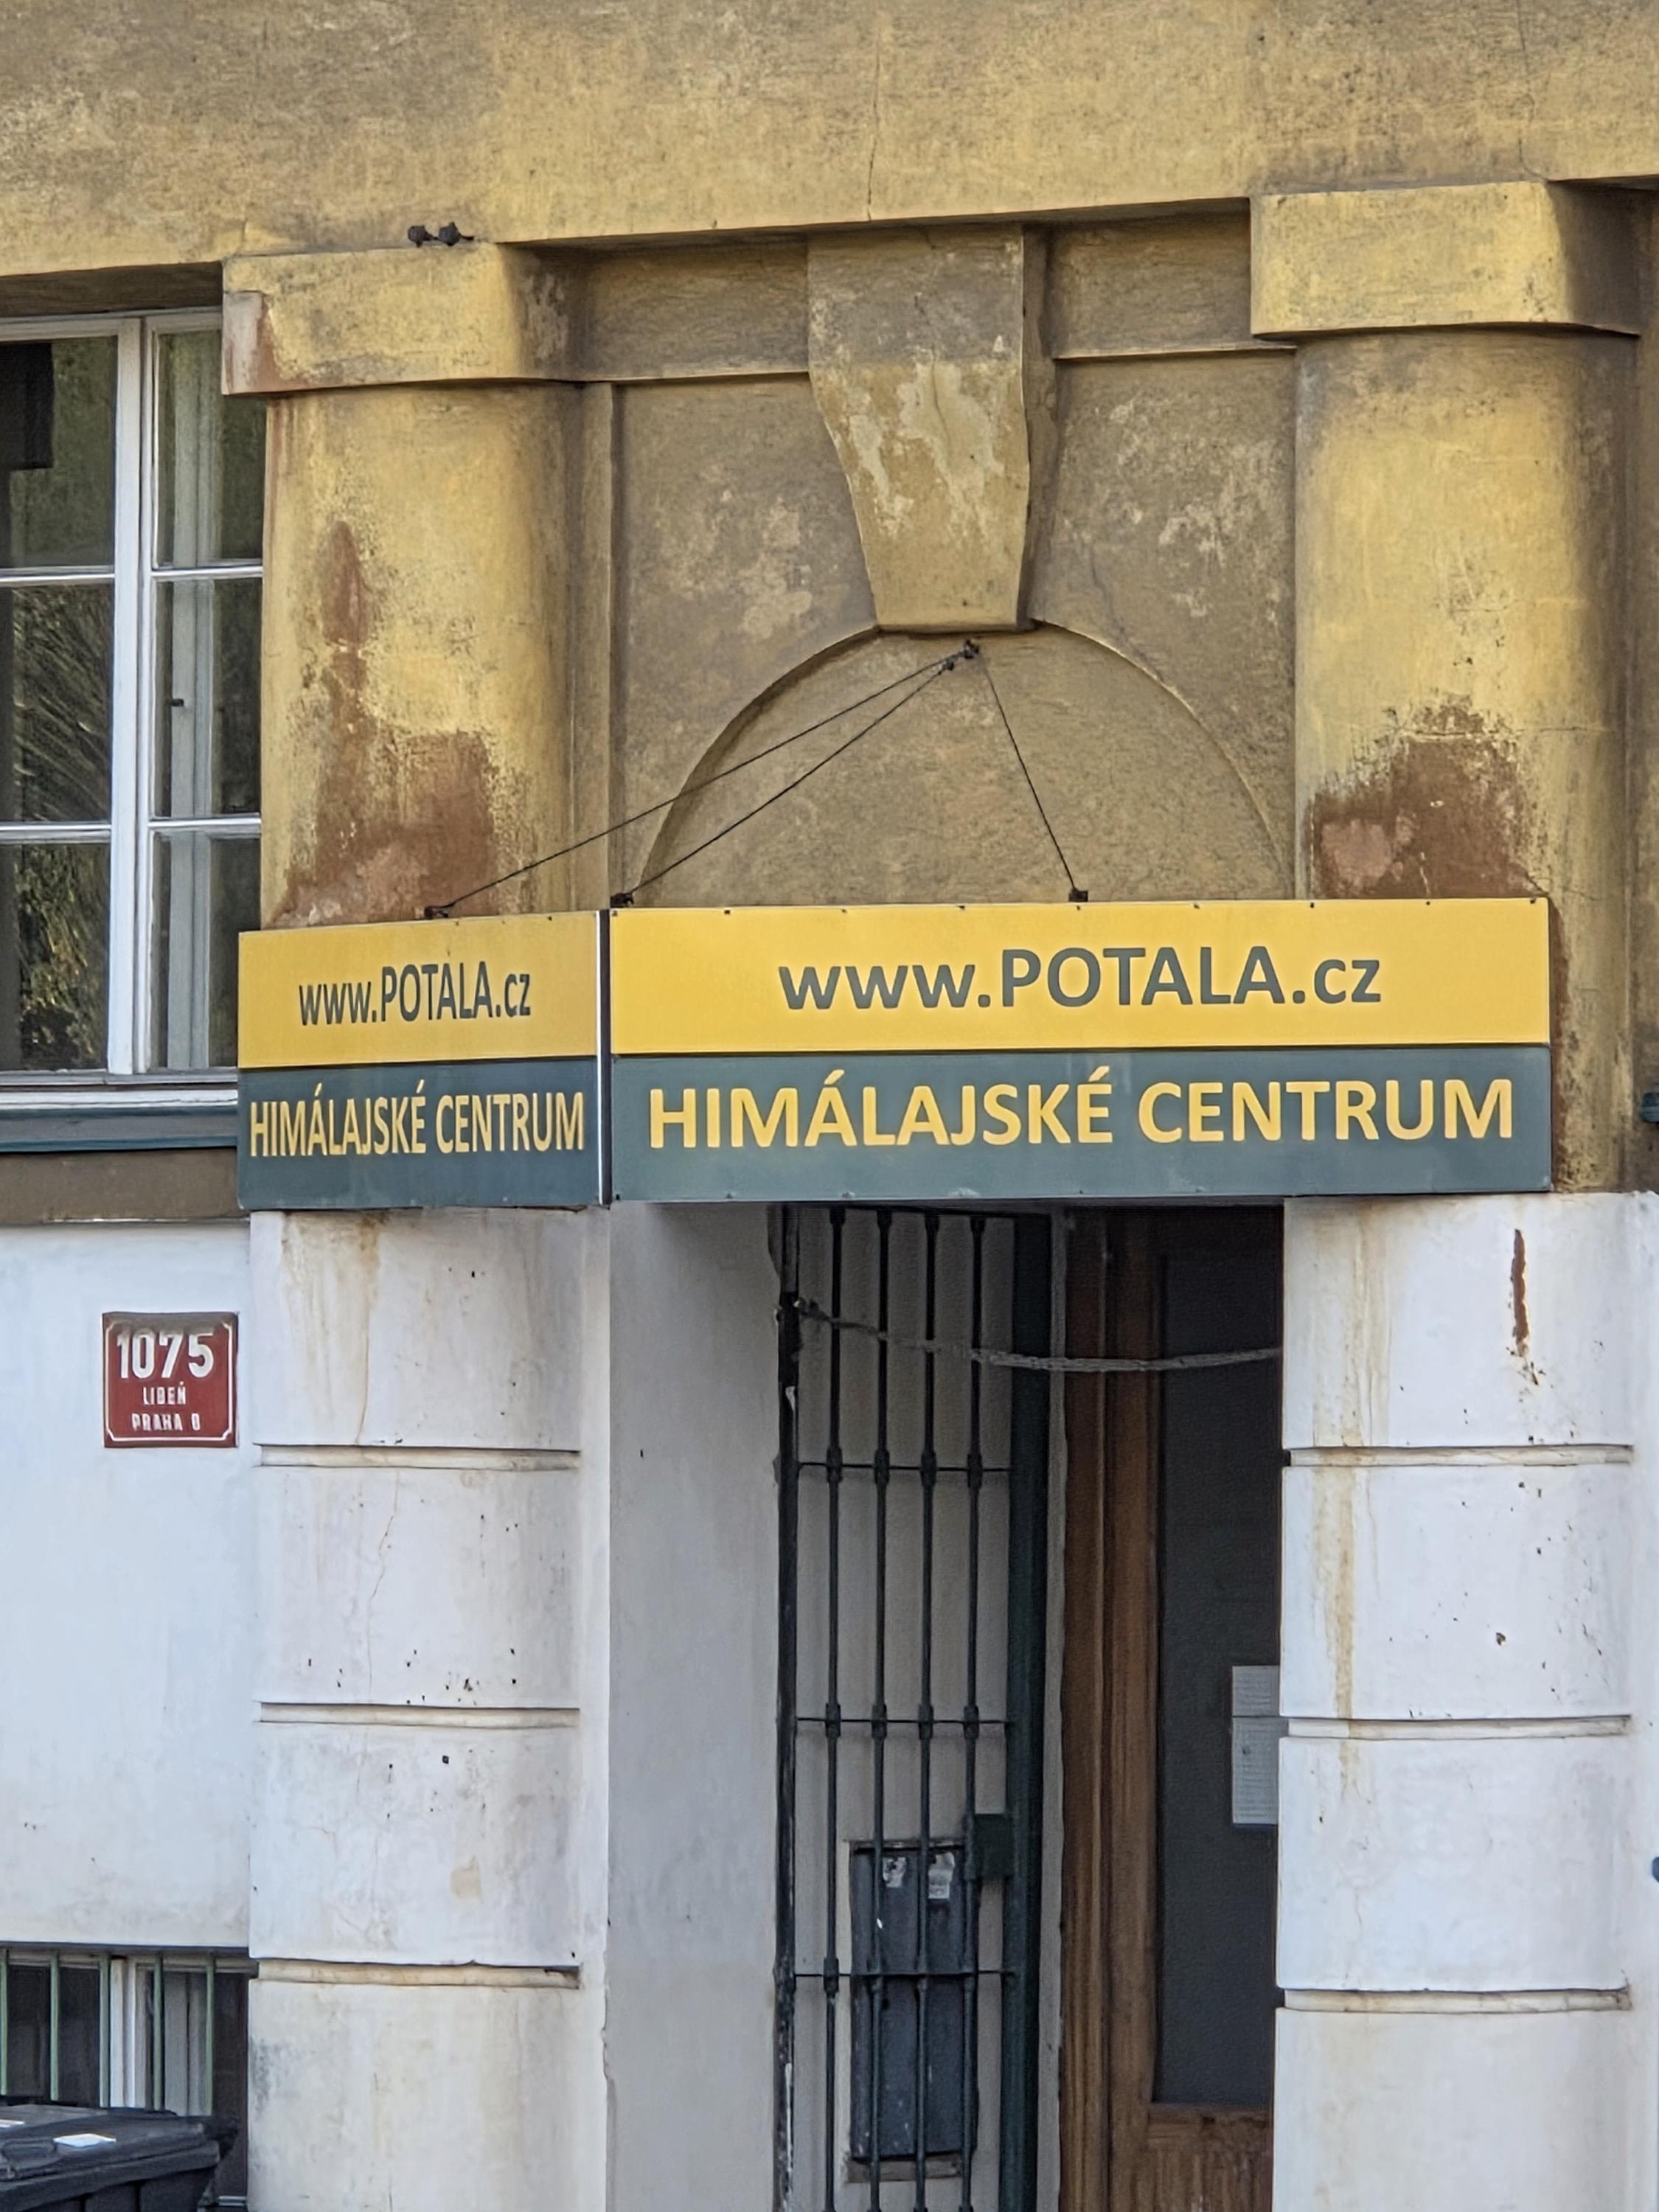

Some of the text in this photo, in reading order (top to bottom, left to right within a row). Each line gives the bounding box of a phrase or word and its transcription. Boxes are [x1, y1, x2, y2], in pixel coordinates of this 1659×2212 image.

[299, 961, 531, 1026] www.POTALA.cz
[779, 946, 1382, 1009] www.POTALA.cz
[250, 1079, 585, 1157] HIMÁLAJSKÉ CENTRUM
[650, 1065, 1512, 1148] HIMÁLAJSKÉ CENTRUM
[116, 1328, 214, 1379] 1075
[131, 1413, 183, 1431] PRAHA
